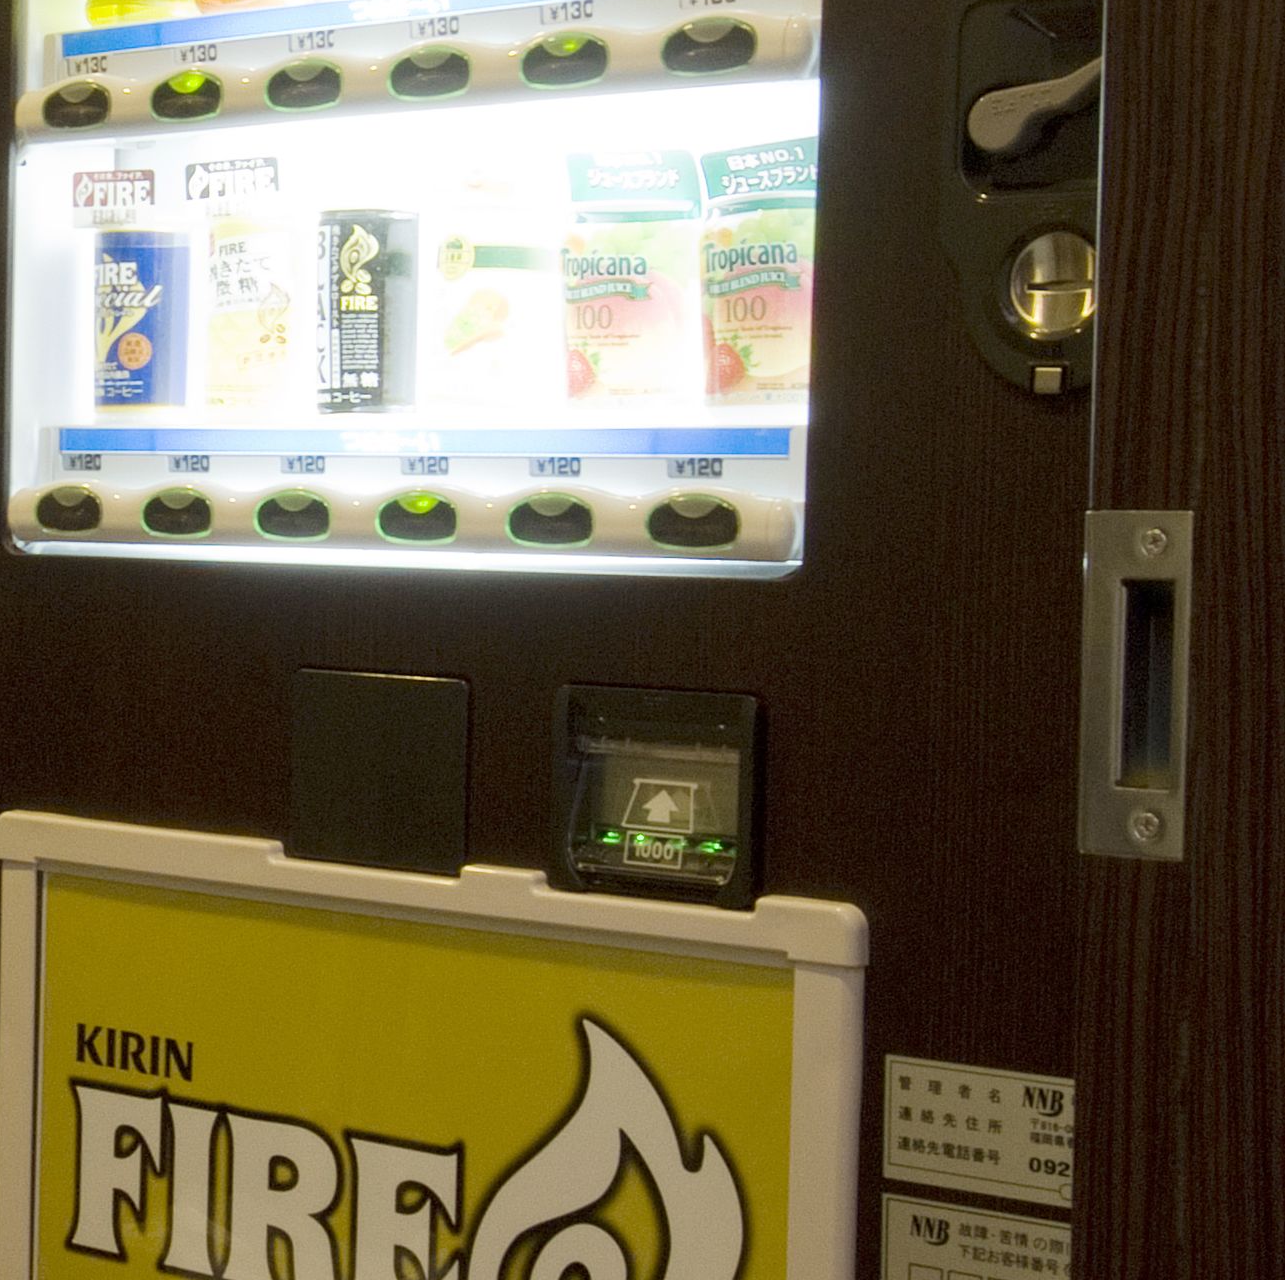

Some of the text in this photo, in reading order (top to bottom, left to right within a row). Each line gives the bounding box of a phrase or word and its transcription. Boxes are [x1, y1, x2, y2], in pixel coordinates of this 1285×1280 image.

[419, 16, 459, 36] ¥130
[180, 44, 217, 63] ¥130
[94, 180, 151, 208] FIRE
[209, 167, 275, 200] FIRE
[560, 248, 648, 280] Tropicana
[702, 239, 798, 275] Tropicana
[96, 262, 138, 285] IRE
[341, 295, 379, 311] FIRE
[725, 294, 767, 324] 100
[575, 304, 614, 331] 100
[175, 456, 210, 472] ¥120
[287, 457, 325, 473] ¥120
[409, 458, 449, 475] ¥120
[537, 458, 580, 475] ¥120
[675, 458, 723, 477] ¥120
[633, 840, 675, 862] 1000
[76, 1022, 195, 1083] KIRIN
[1022, 1085, 1065, 1119] NNB
[897, 1135, 1002, 1167] 連絡先電話番号
[1030, 1131, 1073, 1149] 福岡県
[1028, 1156, 1071, 1178] 092
[910, 1214, 951, 1247] NNB
[958, 1222, 1070, 1256] 故障・苦情の際
[958, 1243, 1073, 1277] 下記お客様番号
